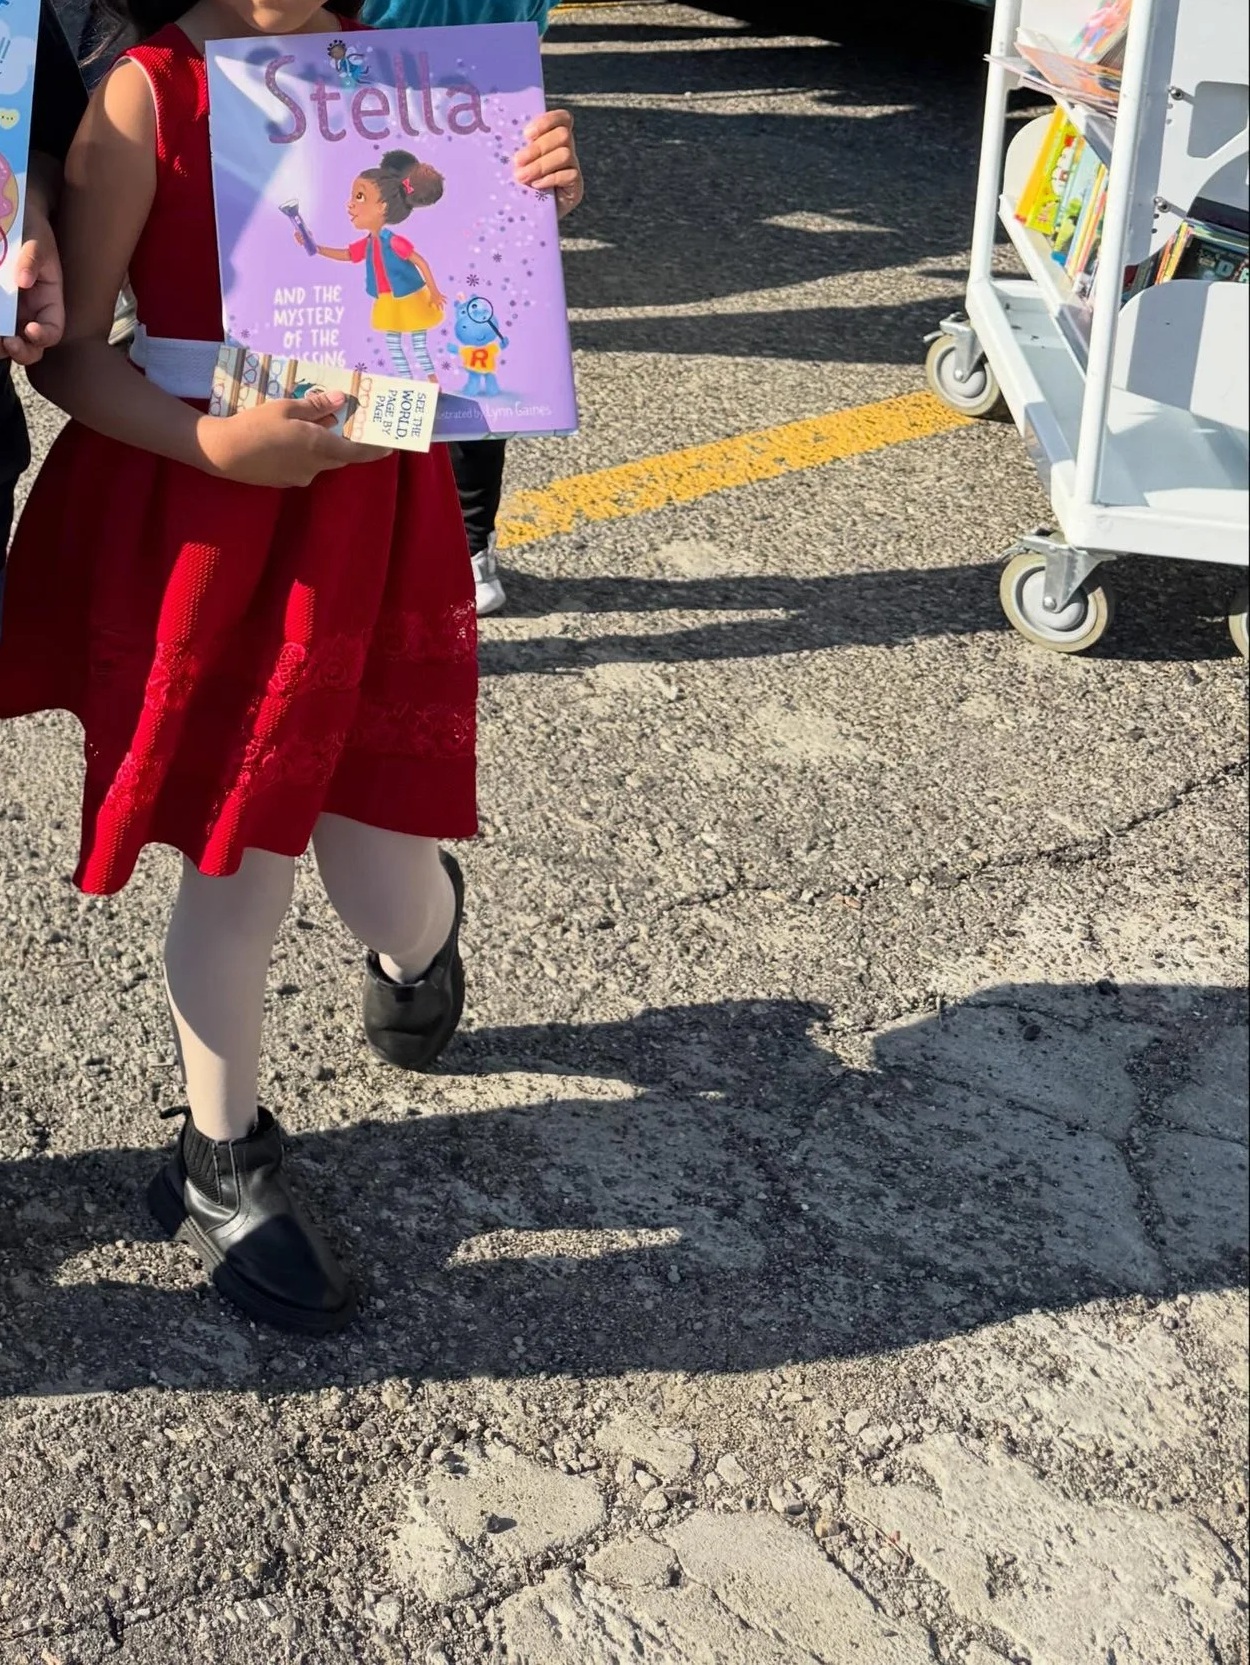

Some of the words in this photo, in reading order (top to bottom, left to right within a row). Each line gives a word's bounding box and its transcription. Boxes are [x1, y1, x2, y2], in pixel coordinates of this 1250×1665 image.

[265, 51, 491, 143] Stella
[273, 287, 306, 305] AND
[313, 284, 342, 303] THE
[273, 306, 345, 327] MYSTERY
[283, 329, 303, 348] OF
[310, 328, 340, 347] THE
[470, 348, 489, 368] R
[373, 395, 386, 422] PAGE
[384, 389, 398, 417] PAGE
[415, 392, 426, 413] SEE
[395, 389, 414, 440] WORLD,
[382, 420, 393, 436] BY
[411, 416, 423, 437] THE
